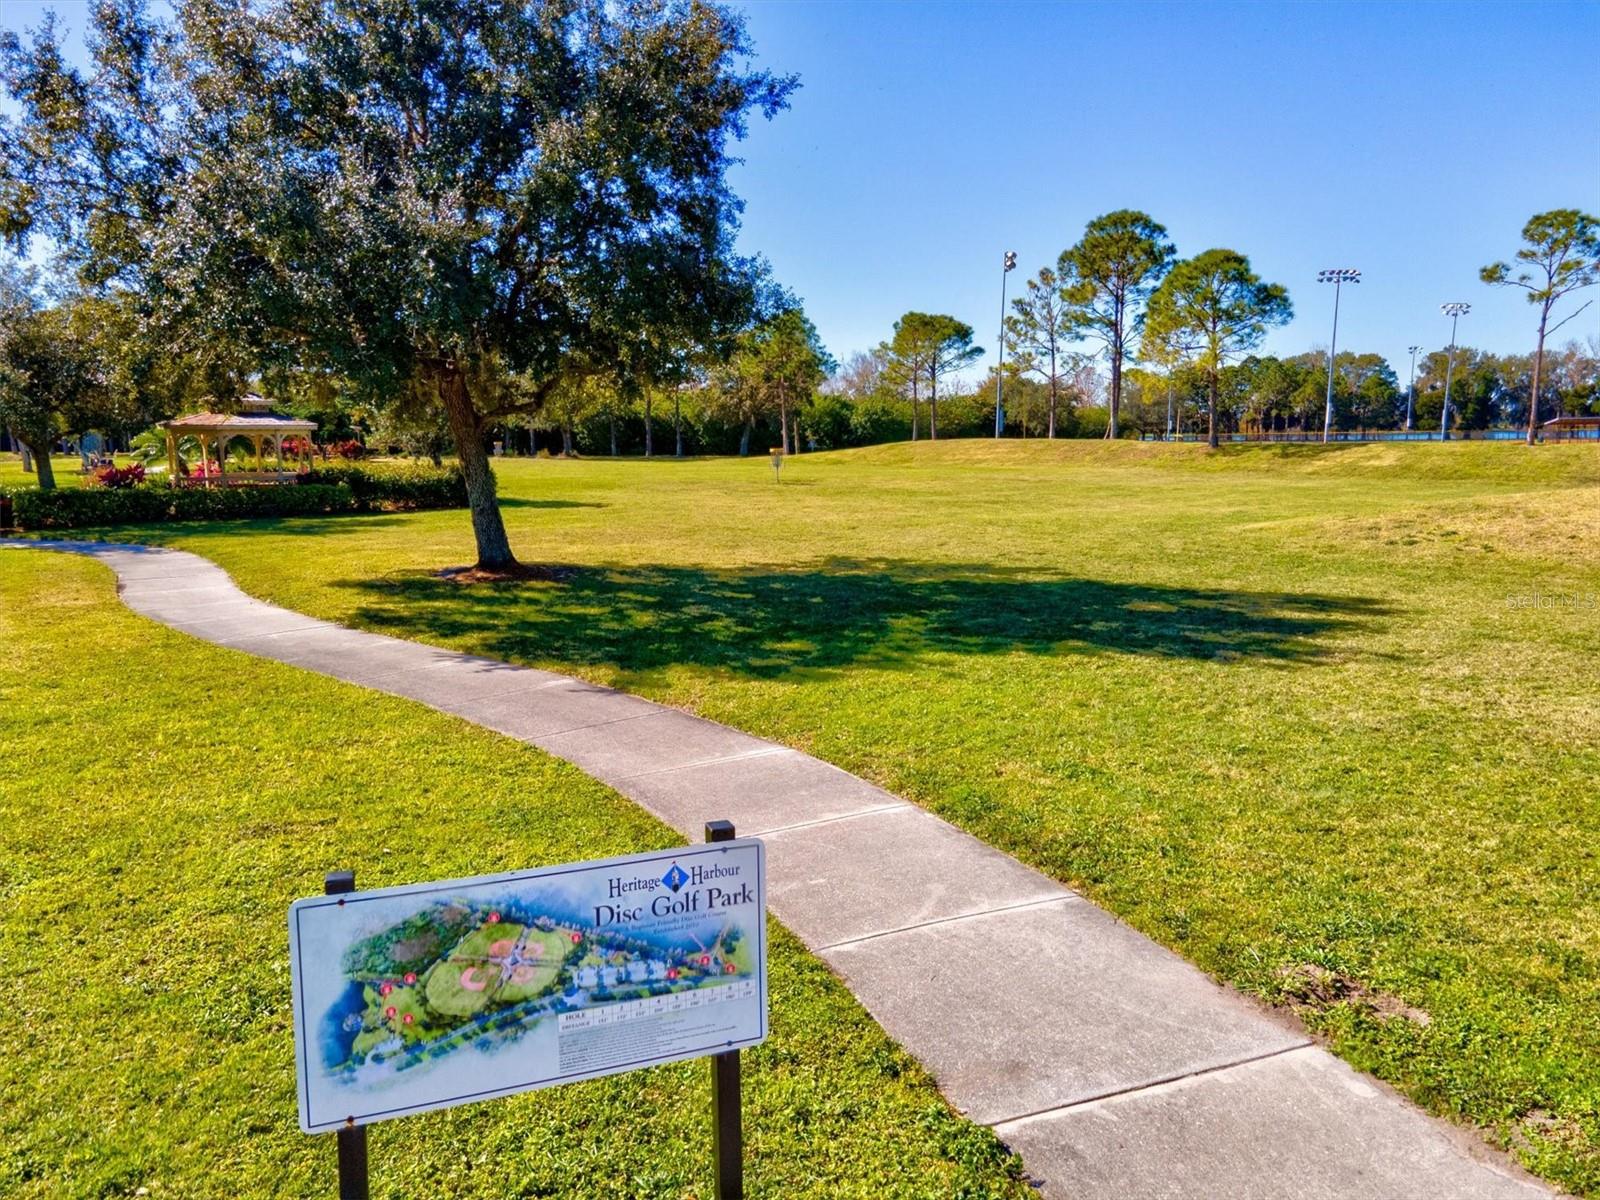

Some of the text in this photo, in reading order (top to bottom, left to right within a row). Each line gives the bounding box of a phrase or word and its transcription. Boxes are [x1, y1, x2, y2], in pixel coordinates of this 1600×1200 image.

[608, 864, 741, 898] Heritage Harbour
[594, 883, 754, 927] Disc Golf Park
[565, 1012, 586, 1021] HOLE
